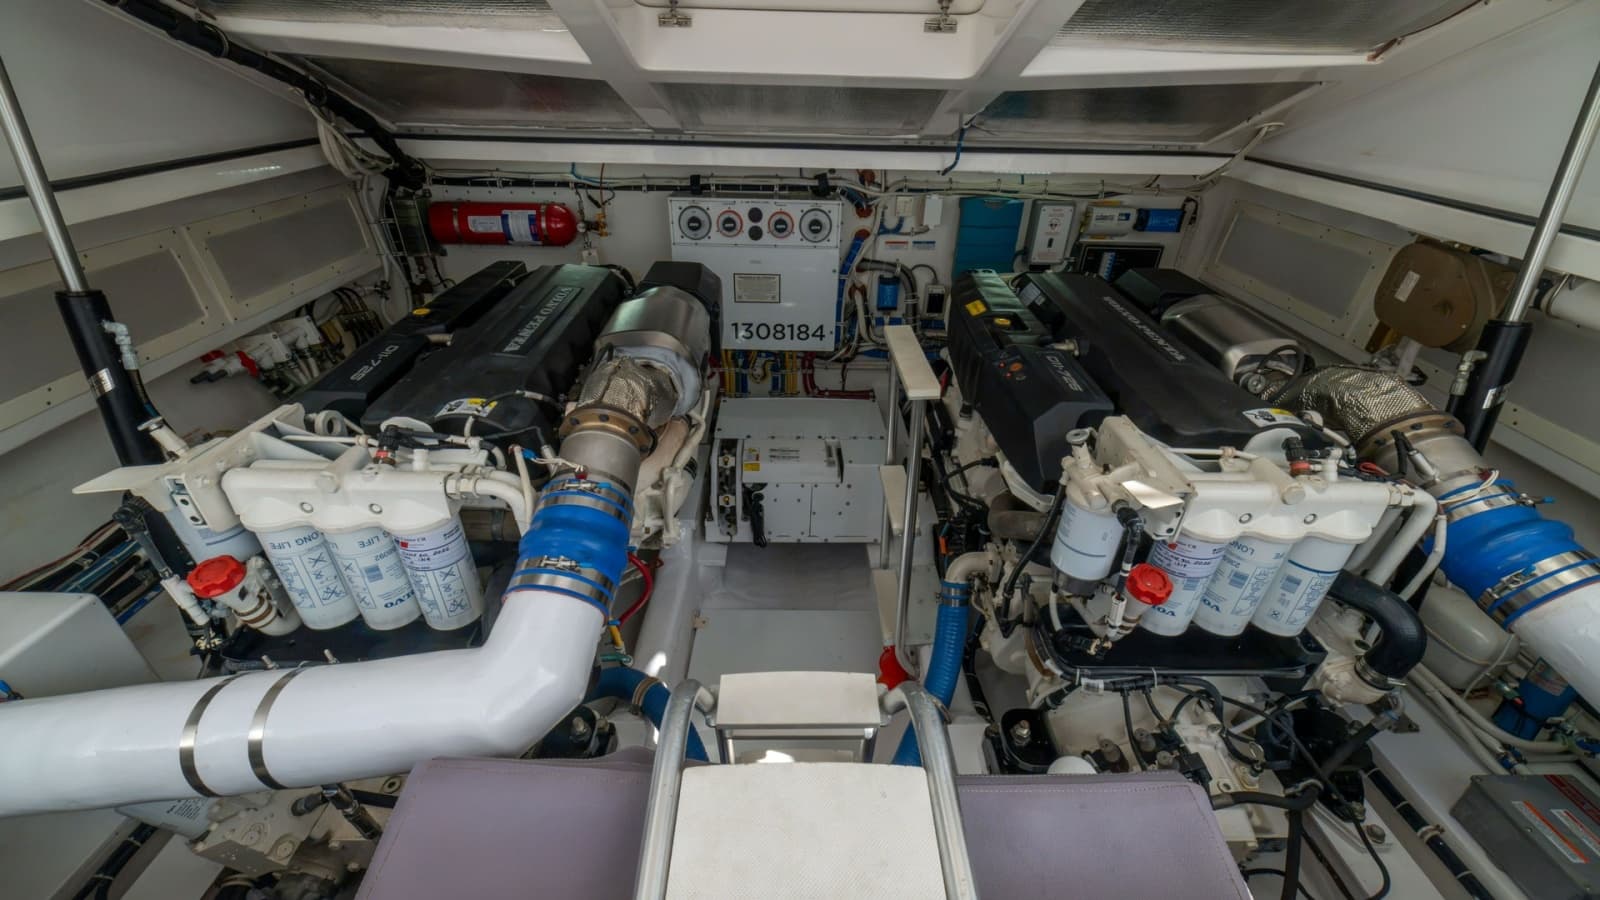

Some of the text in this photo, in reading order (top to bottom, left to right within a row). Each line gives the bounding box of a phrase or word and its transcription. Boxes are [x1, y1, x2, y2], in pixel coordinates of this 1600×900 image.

[503, 288, 572, 352] VOLVO PENTA
[731, 322, 826, 342] 1308184
[268, 541, 292, 550] LIFE
[295, 531, 319, 546] ONG
[358, 535, 381, 549] LIFE
